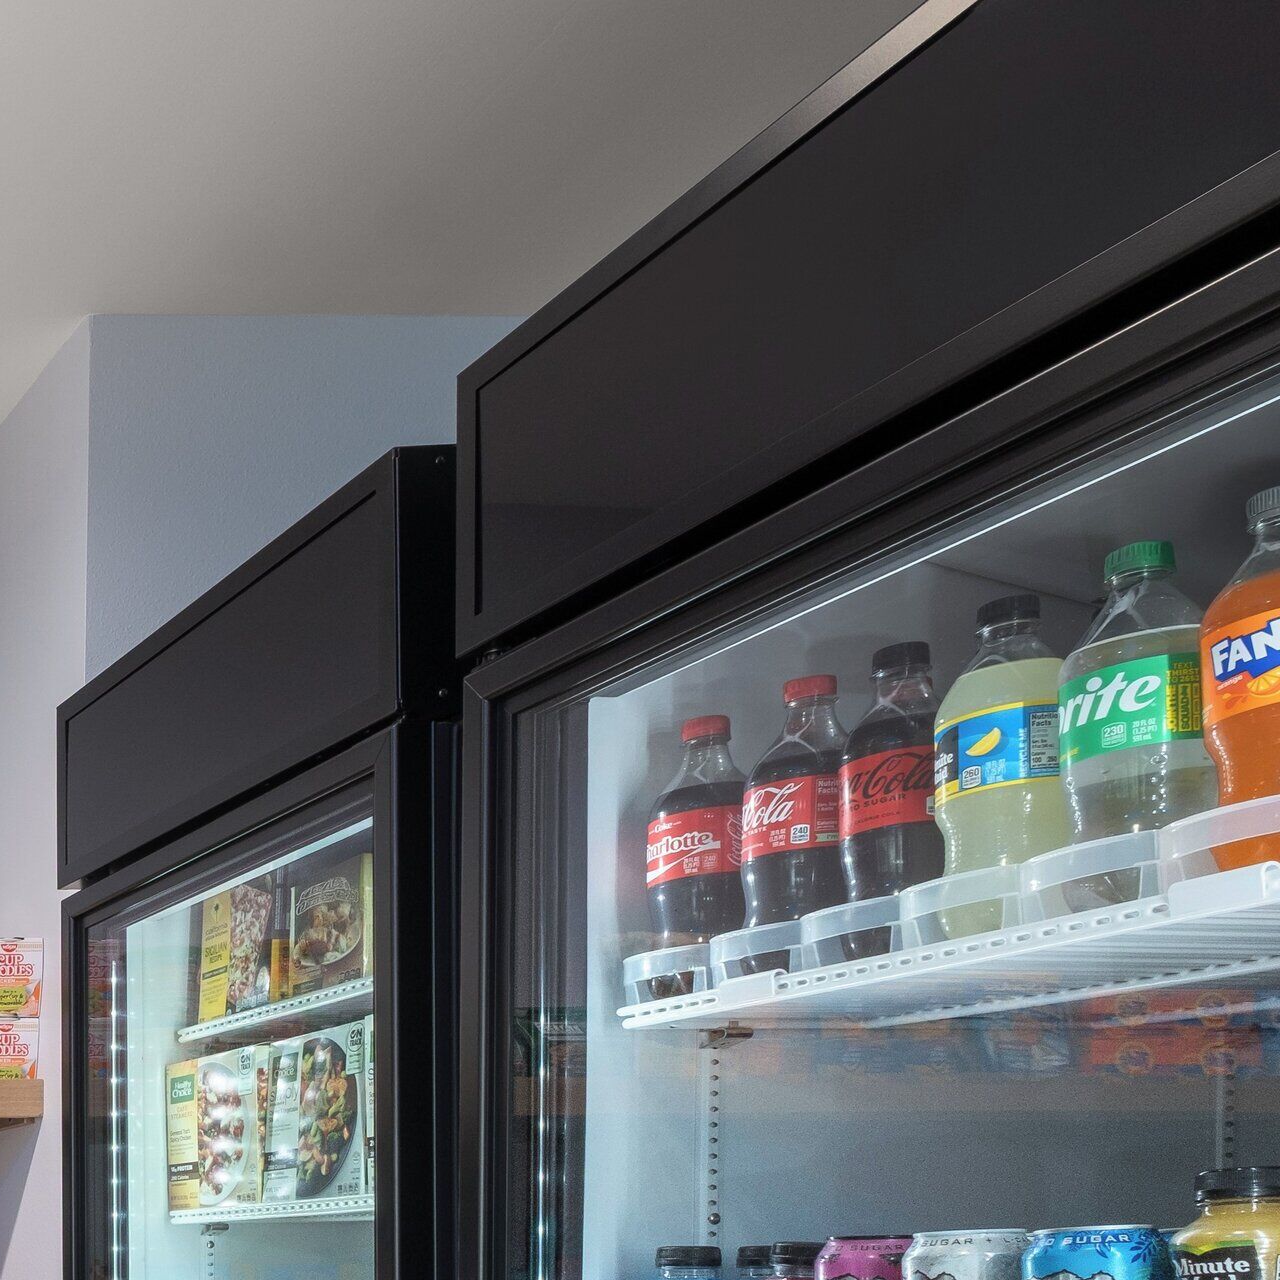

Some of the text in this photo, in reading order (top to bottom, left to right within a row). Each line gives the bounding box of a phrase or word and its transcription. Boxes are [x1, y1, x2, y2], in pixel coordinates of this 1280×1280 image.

[1217, 675, 1243, 690] orange
[1104, 724, 1123, 736] 230
[963, 768, 980, 779] 260
[863, 793, 907, 809] SUGAR
[792, 826, 809, 835] 240
[172, 1088, 192, 1098] Choice
[920, 1237, 974, 1248] SUGAR
[1064, 1232, 1131, 1244] SUGAR
[1175, 1256, 1251, 1277] Minute
